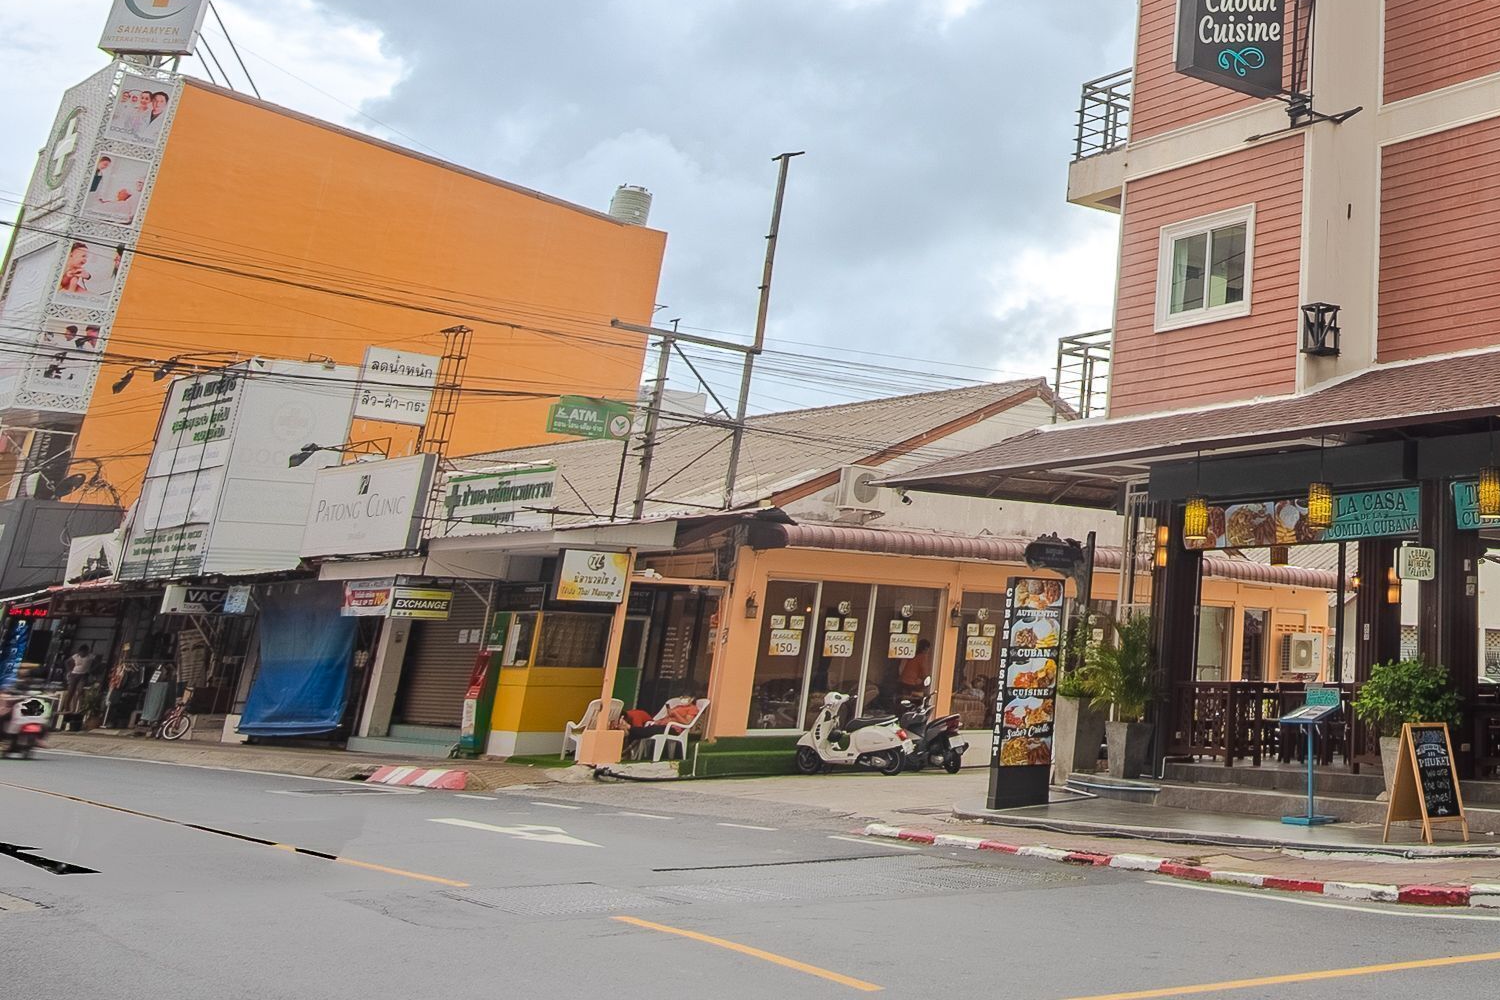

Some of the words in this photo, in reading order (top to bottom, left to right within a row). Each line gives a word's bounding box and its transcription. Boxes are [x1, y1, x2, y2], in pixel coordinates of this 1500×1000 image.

[116, 24, 180, 36] SAINAMYEN
[1199, 15, 1281, 44] Cuisine
[569, 408, 598, 422] ATM
[316, 499, 362, 522] PATONG
[366, 493, 406, 518] CLINIC
[1336, 496, 1358, 518] LA
[1362, 491, 1408, 511] CASA
[1327, 522, 1370, 538] COMIDA
[1373, 517, 1419, 534] CUBANA
[395, 599, 448, 610] EXCHANGE
[1002, 588, 1013, 640] CUBAN
[1016, 609, 1059, 618] AUTHENTIC
[1017, 648, 1052, 658] CUBAN
[1012, 688, 1049, 697] CUISINE
[992, 647, 1008, 757] RESTAURANT
[1418, 756, 1450, 768] PHUKET
